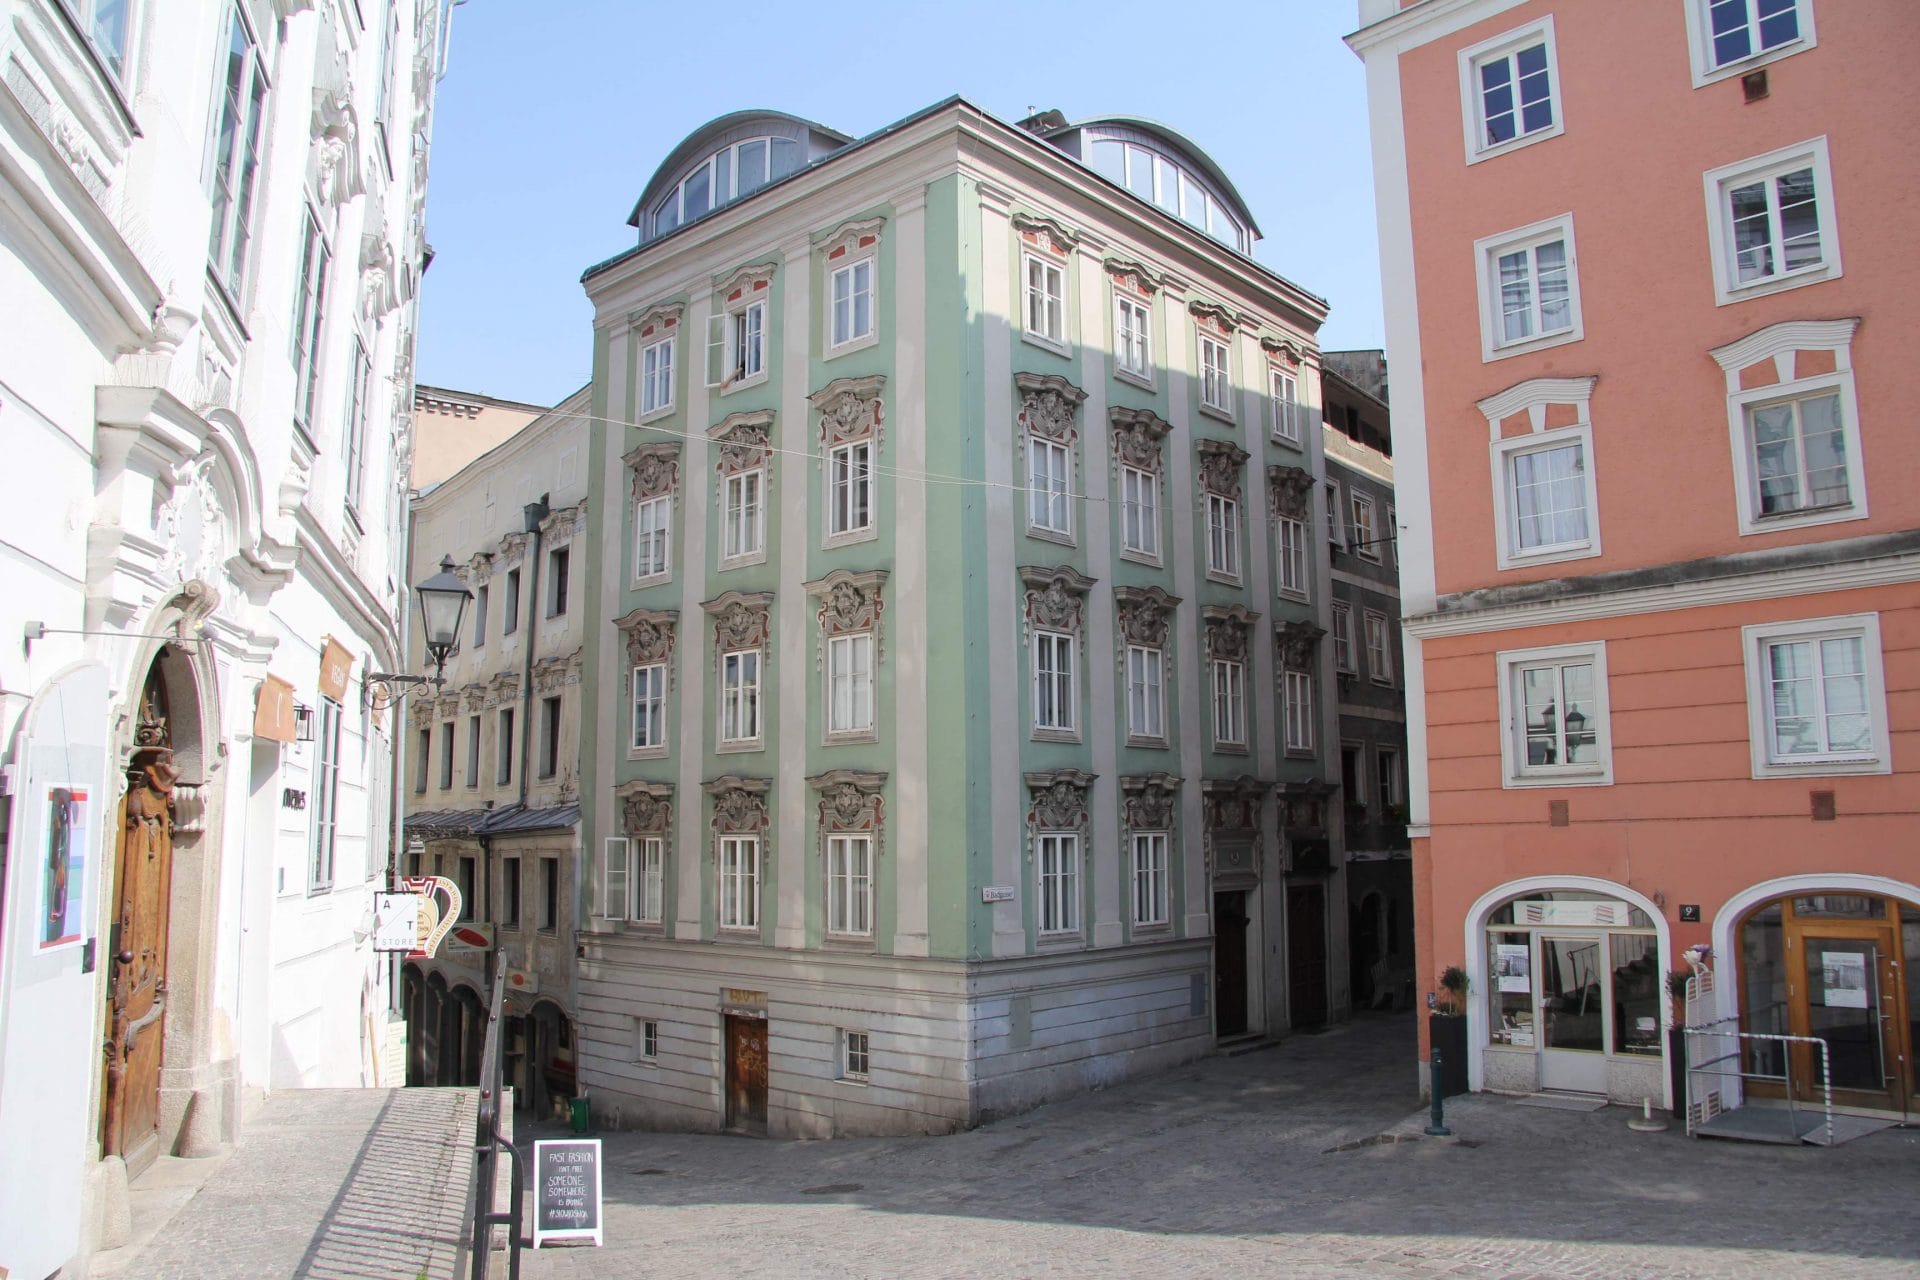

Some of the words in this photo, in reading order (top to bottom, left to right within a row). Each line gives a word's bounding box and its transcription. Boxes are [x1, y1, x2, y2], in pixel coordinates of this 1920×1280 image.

[383, 900, 391, 909] A
[1685, 906, 1692, 916] 9
[406, 920, 413, 930] T
[382, 938, 415, 946] STORE
[549, 1153, 565, 1163] FAST
[568, 1152, 594, 1163] FASHION
[547, 1175, 585, 1186] SOMEONE
[548, 1186, 588, 1197] SOMEWHERE
